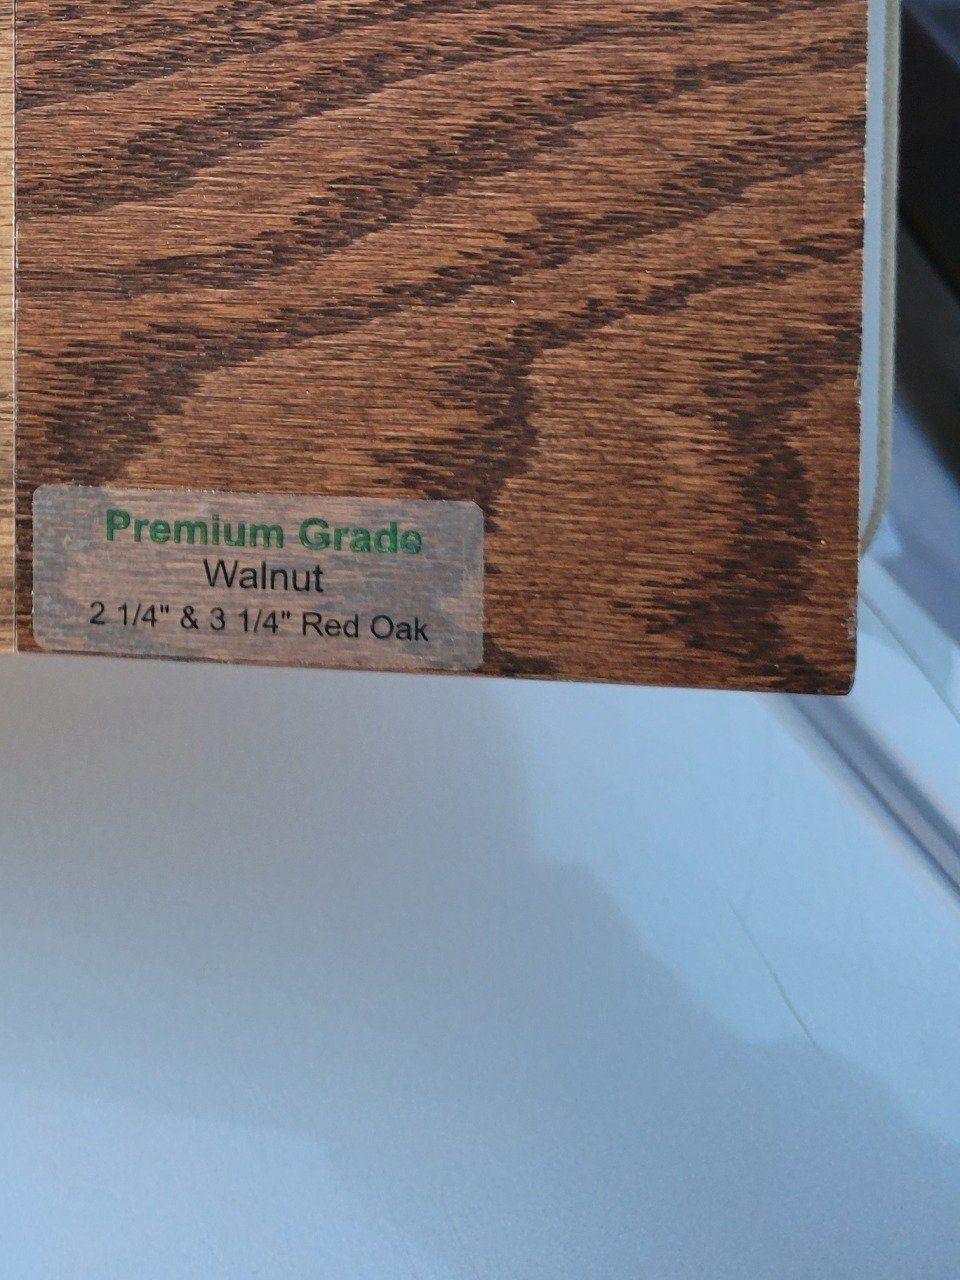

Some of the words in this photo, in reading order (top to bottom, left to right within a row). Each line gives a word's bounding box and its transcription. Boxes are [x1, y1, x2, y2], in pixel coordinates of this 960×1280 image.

[106, 509, 284, 550] Premium
[299, 518, 422, 554] Grade
[202, 558, 323, 593] Walnut
[90, 601, 105, 625] 2
[117, 603, 170, 628] 1/4"
[180, 605, 198, 629] &
[210, 607, 226, 631] 3
[239, 608, 290, 635] 1/4"
[302, 611, 359, 638] Red
[371, 614, 428, 642] Oak
